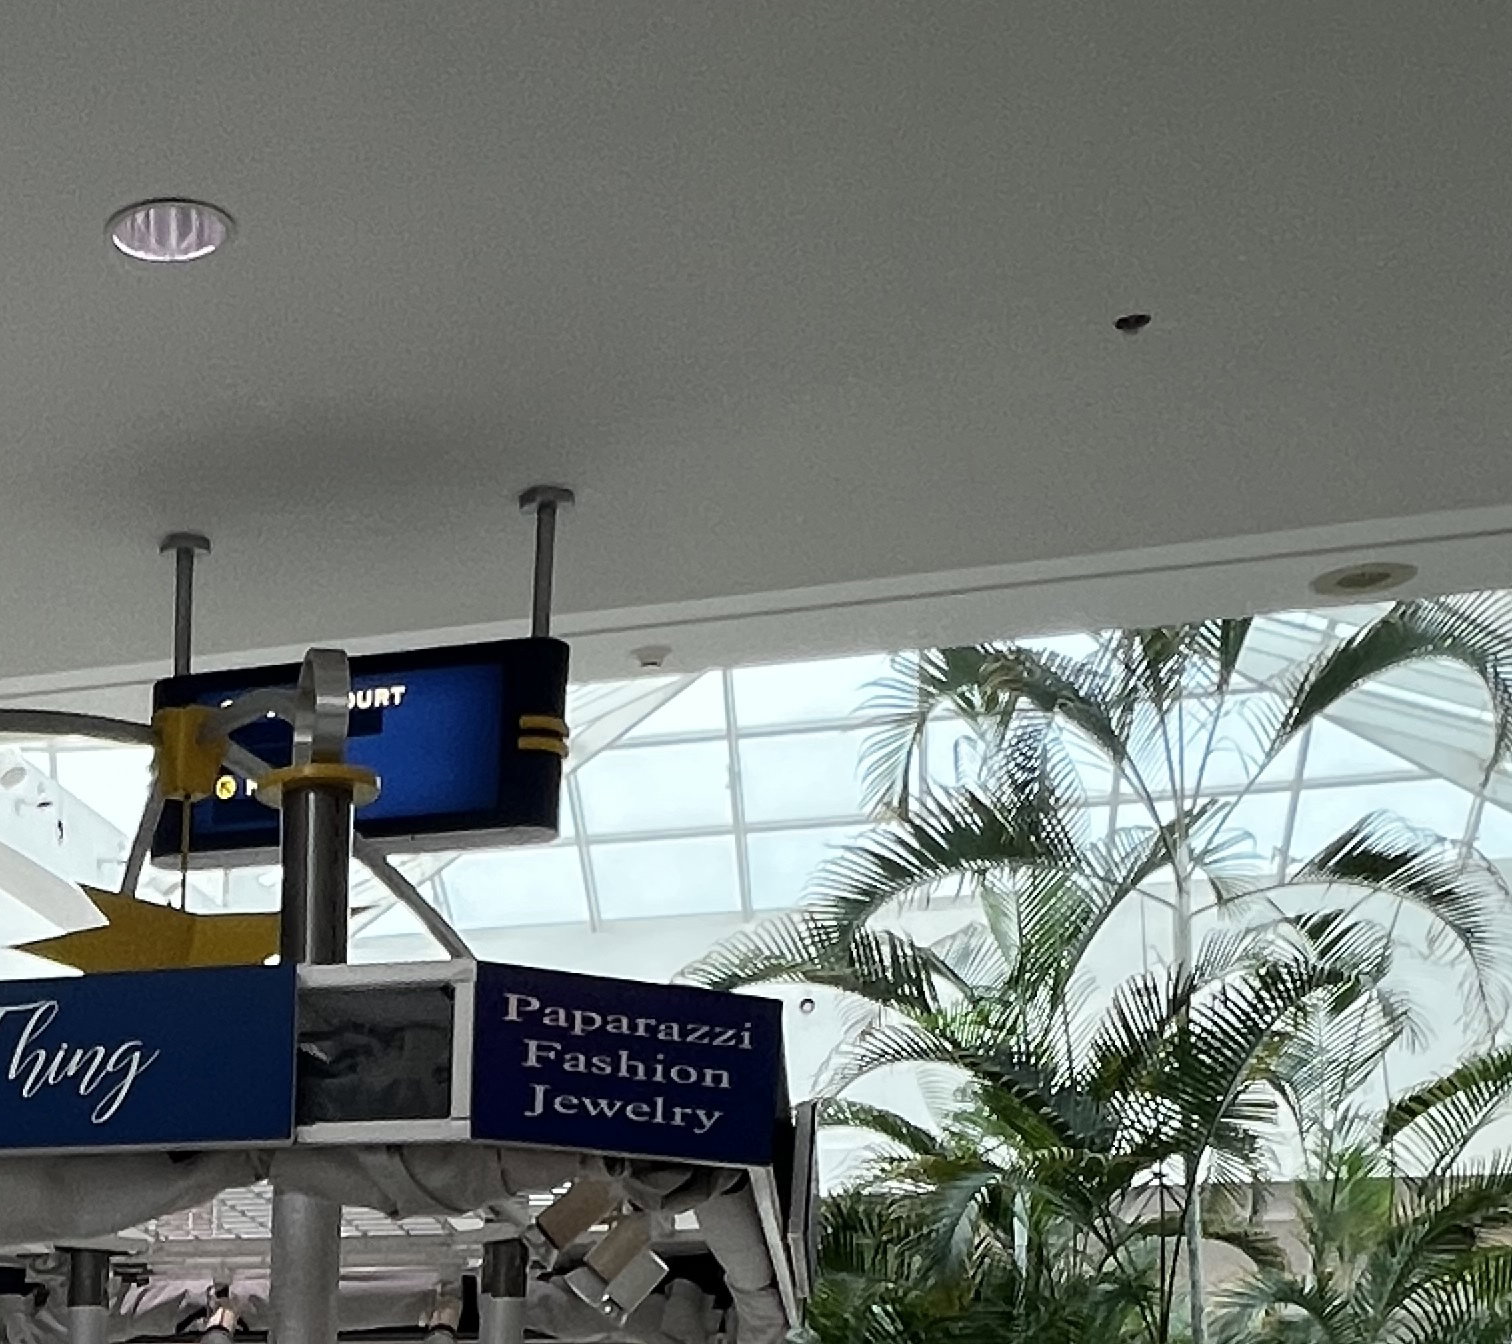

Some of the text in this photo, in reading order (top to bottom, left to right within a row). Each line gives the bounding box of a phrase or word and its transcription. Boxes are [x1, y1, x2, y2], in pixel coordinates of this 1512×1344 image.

[502, 992, 754, 1051] Paparazzi
[521, 1038, 733, 1090] Fashion
[523, 1083, 725, 1135] Jewelry
